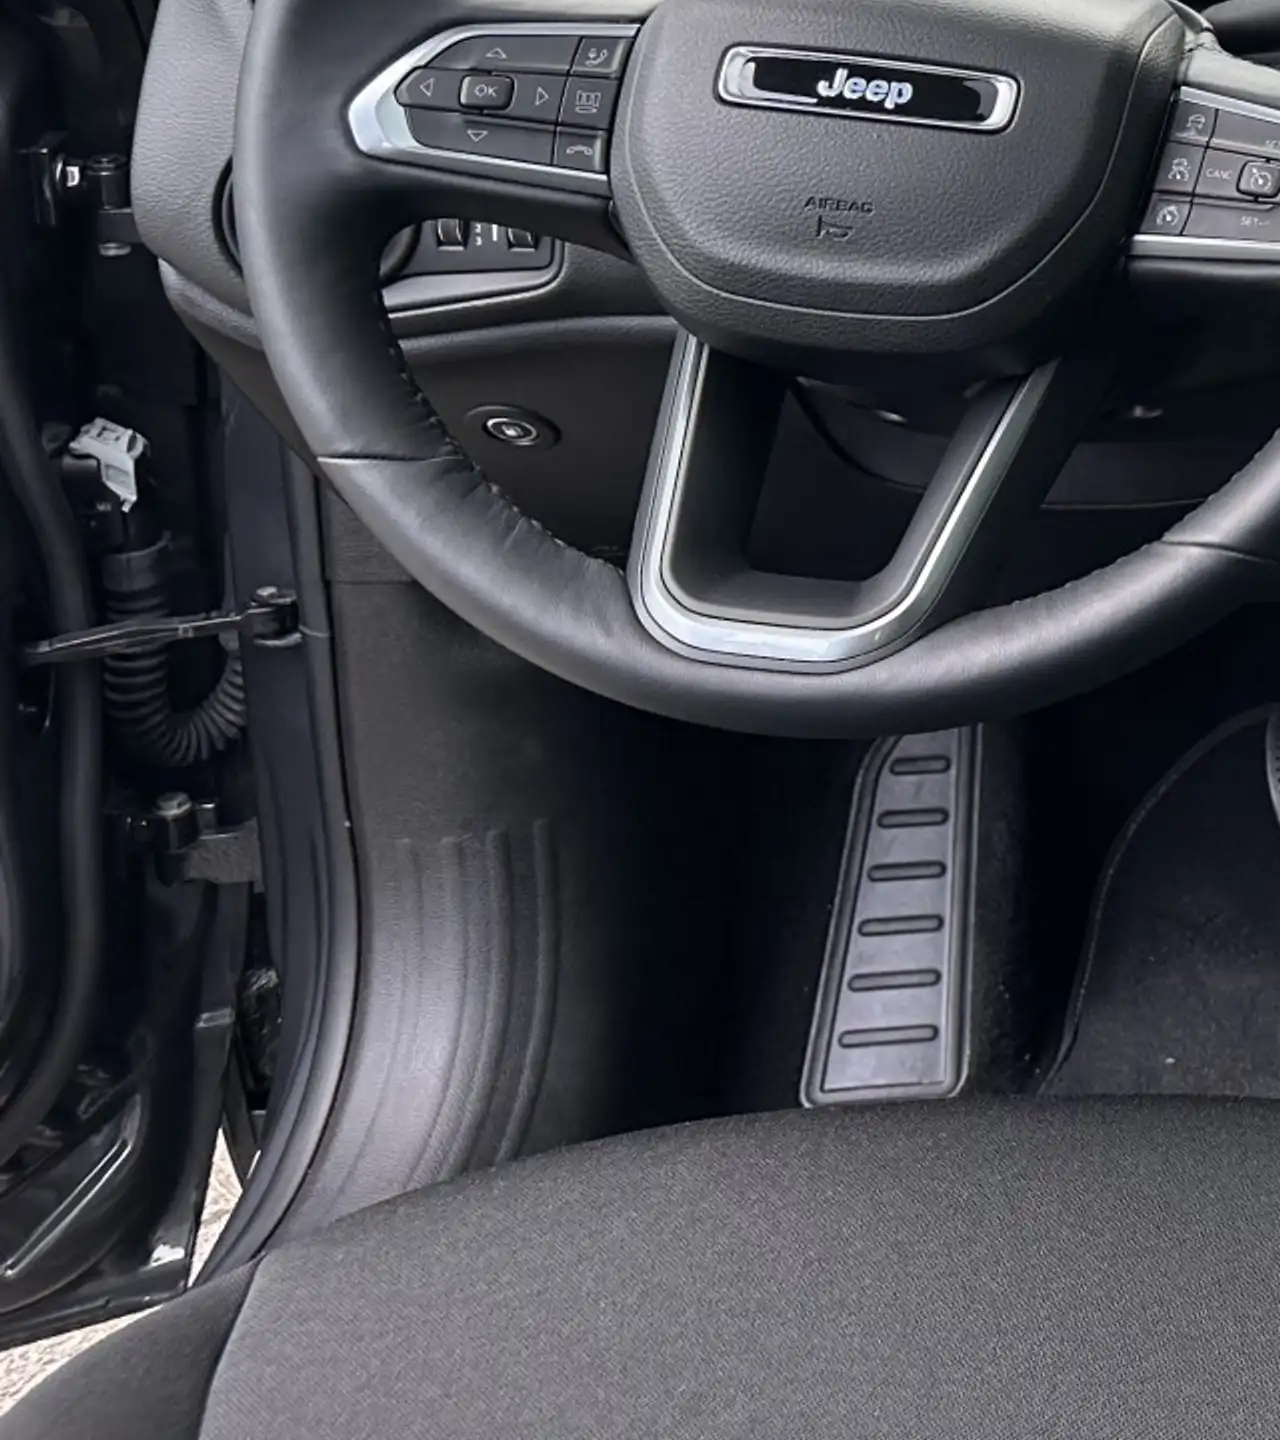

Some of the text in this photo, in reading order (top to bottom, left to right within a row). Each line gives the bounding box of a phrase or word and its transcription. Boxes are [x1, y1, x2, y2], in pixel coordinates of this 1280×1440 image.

[473, 82, 498, 98] OK
[816, 67, 914, 109] Jeep
[1206, 167, 1234, 180] CANC
[803, 195, 875, 215] AIRBAG
